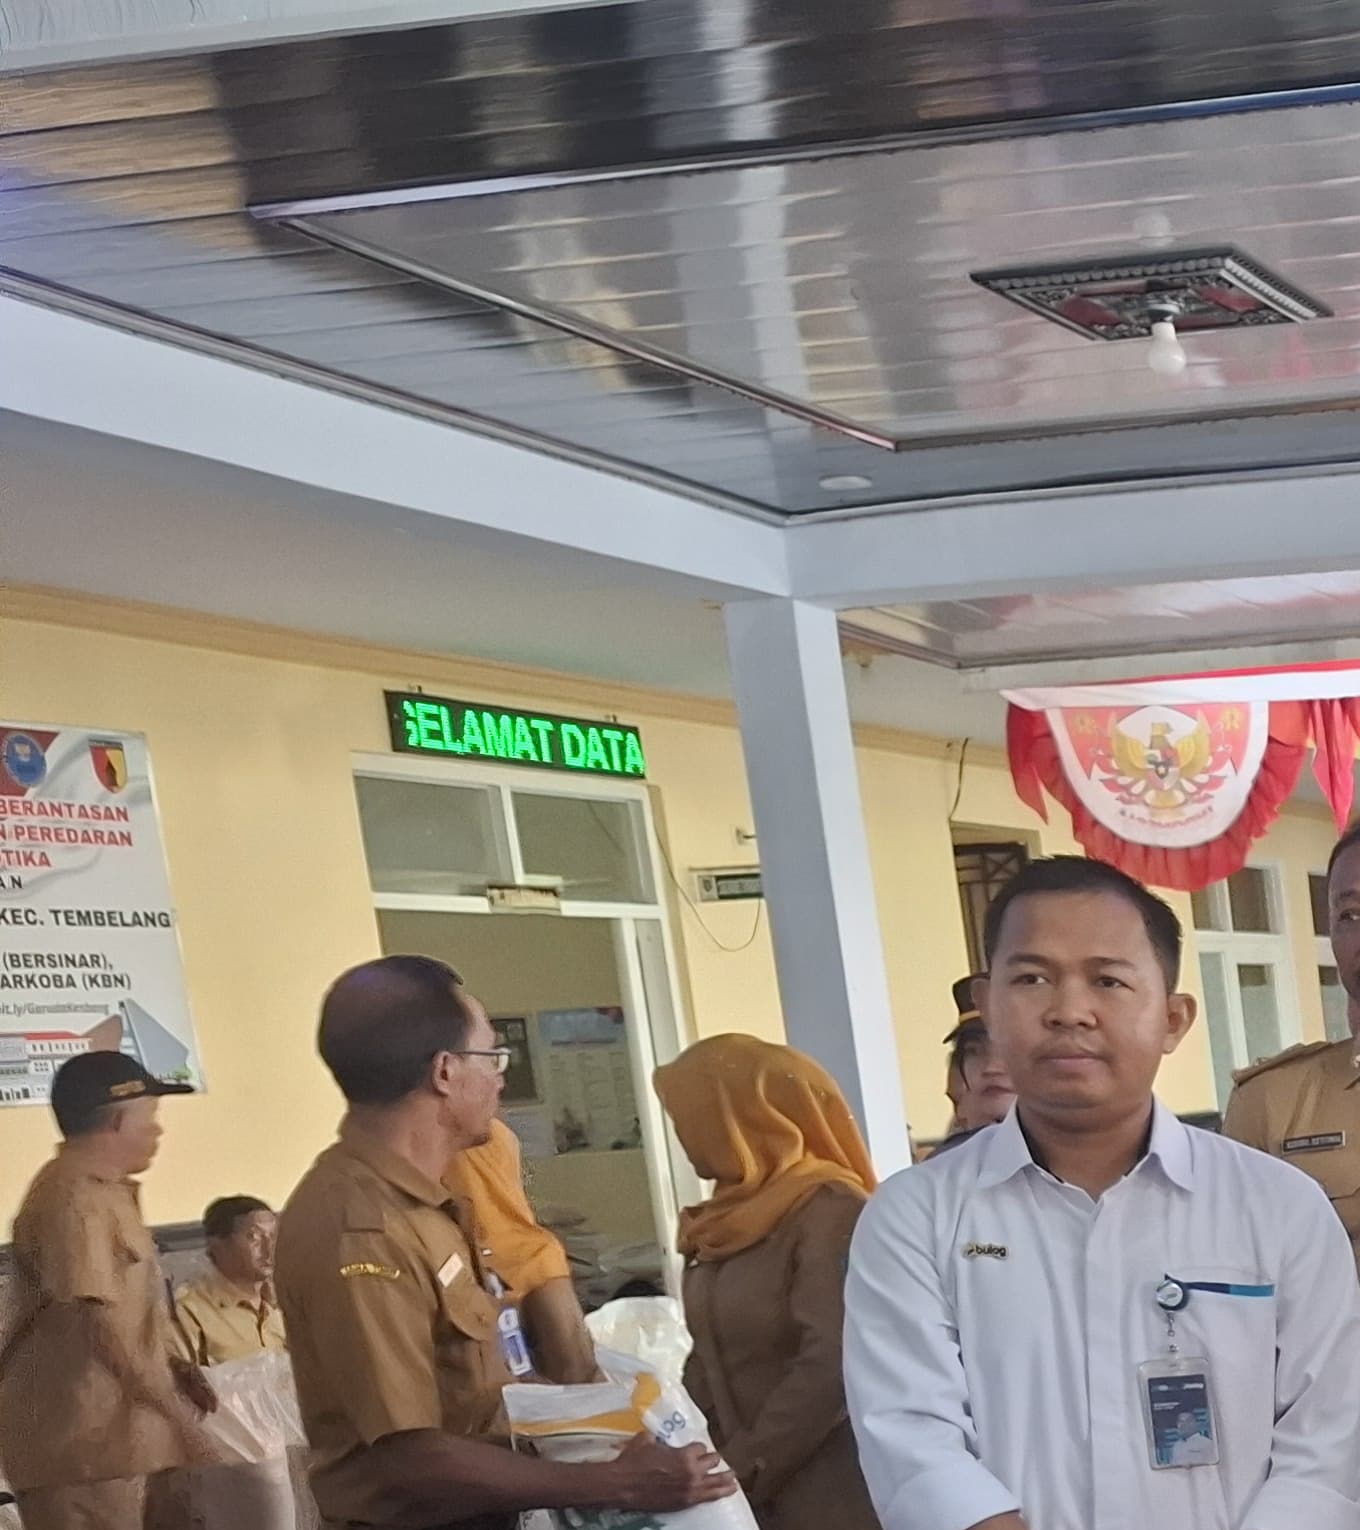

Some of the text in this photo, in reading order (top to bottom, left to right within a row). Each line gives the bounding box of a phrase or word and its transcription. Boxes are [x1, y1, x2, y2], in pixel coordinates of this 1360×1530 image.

[561, 722, 645, 776] DATA
[14, 825, 133, 846] PEREDARAN
[50, 909, 171, 928] TEMBELANG
[3, 952, 113, 970] (BERSINAR),
[82, 973, 131, 990] (KBN)
[975, 1244, 1007, 1257] bulog
